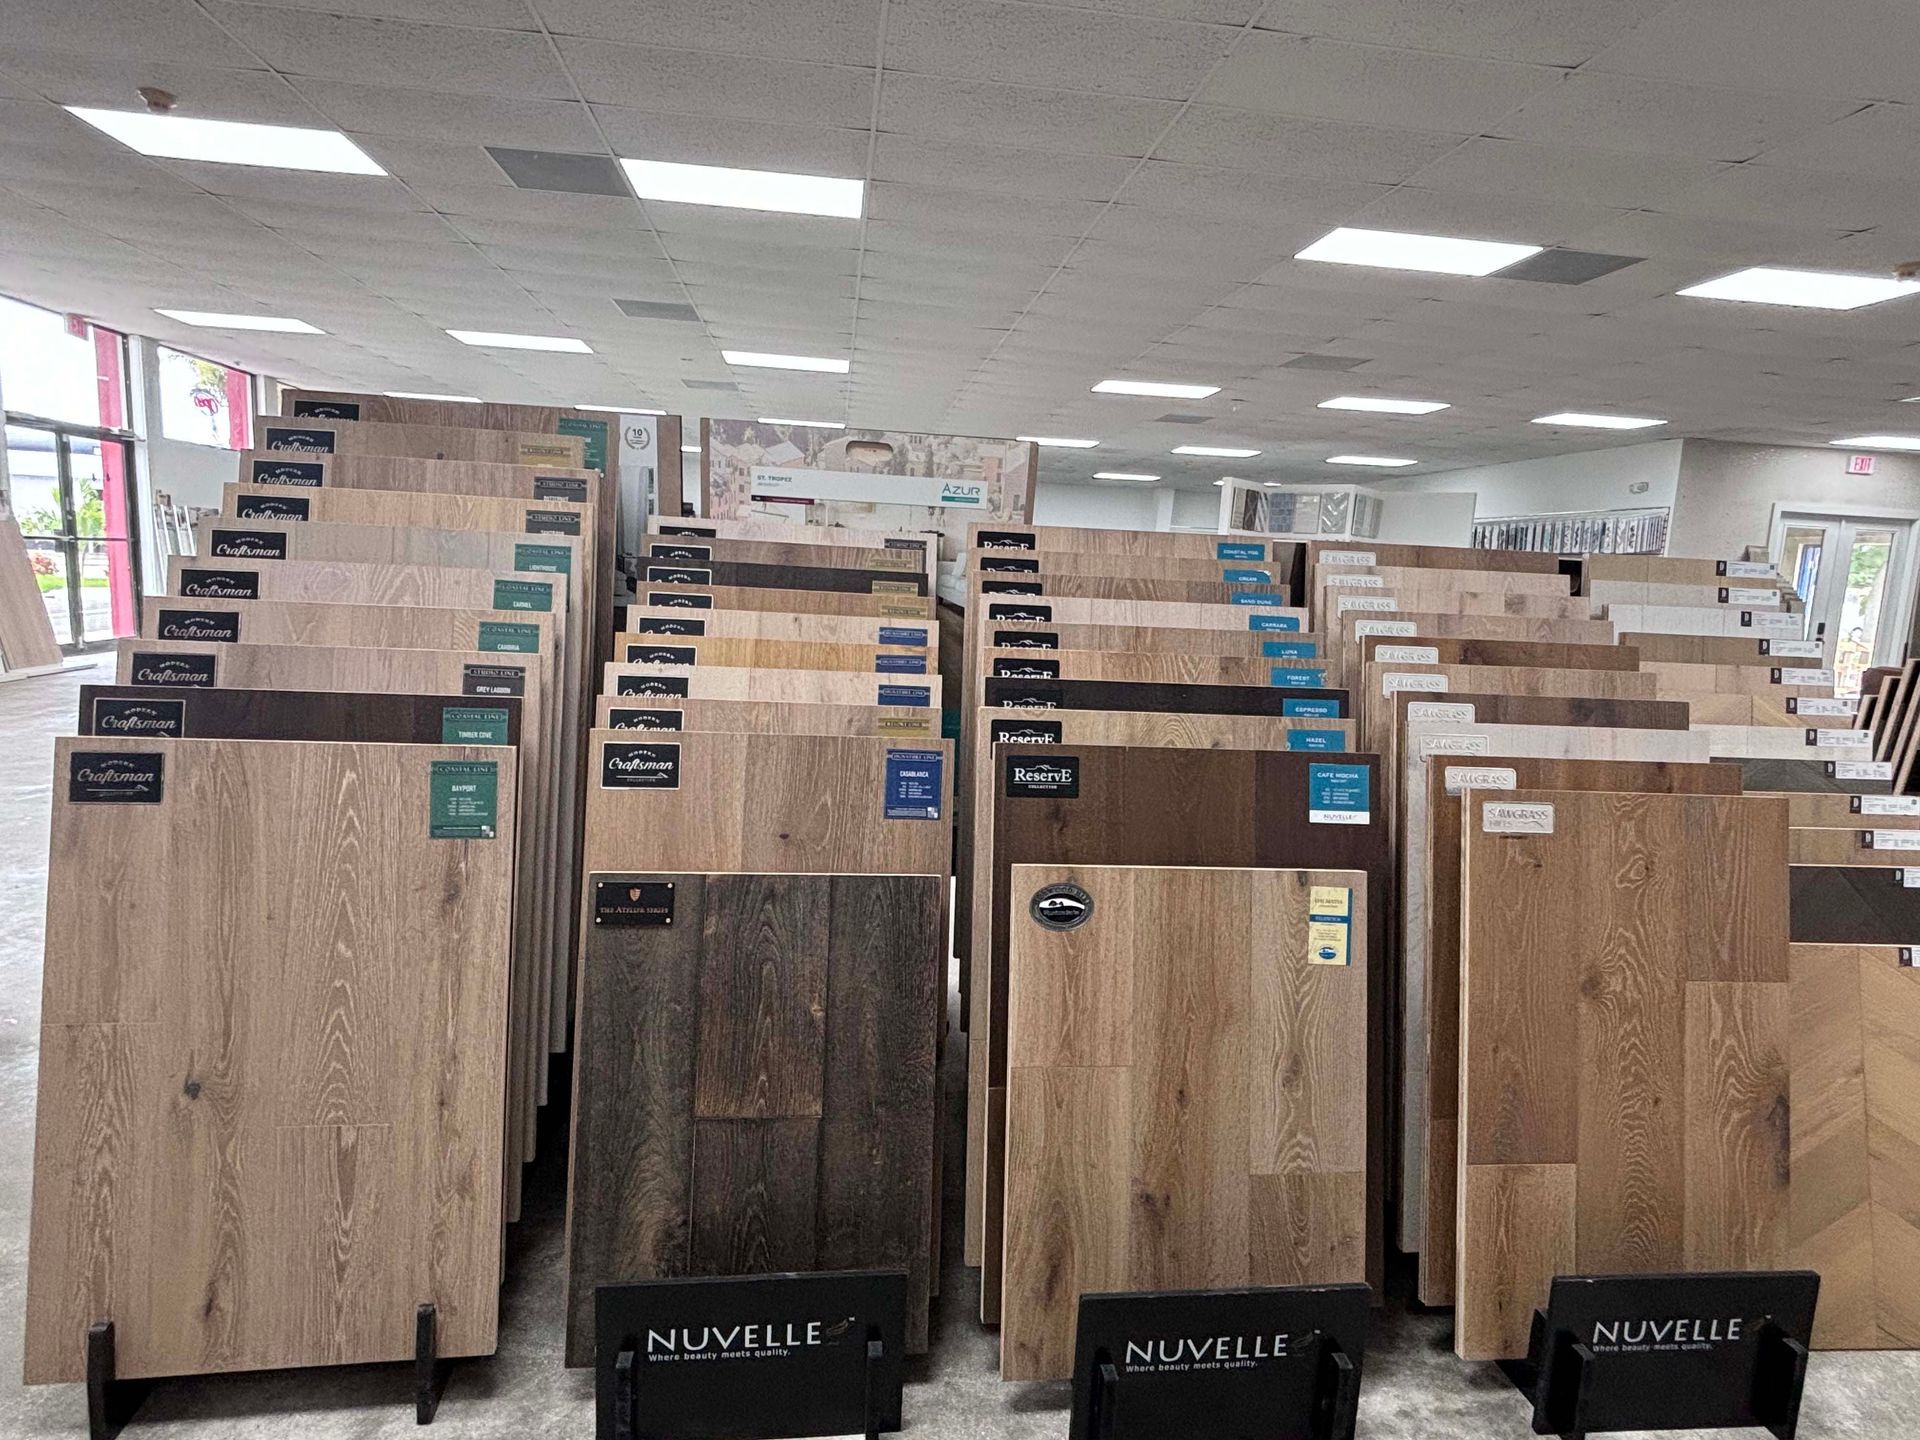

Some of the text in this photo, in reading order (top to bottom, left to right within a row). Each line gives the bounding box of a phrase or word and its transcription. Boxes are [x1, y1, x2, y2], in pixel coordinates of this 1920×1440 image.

[271, 440, 329, 453] Craftsman
[1854, 457, 1872, 472] EXIT
[258, 473, 317, 486] Craftsman
[241, 508, 303, 521] Craftsman
[216, 543, 280, 557] Craftsman
[186, 583, 252, 598] Craftsman
[164, 625, 232, 639] Craftsman
[137, 668, 208, 683] Craftsman
[101, 715, 177, 731] Craftsman
[608, 757, 673, 772] Craftsman
[77, 768, 154, 784] Craftsman
[900, 770, 928, 778] CASABLANCA
[647, 1321, 822, 1353] NUVELLE
[1592, 1318, 1743, 1344] NUVELLE
[1125, 1334, 1289, 1364] NUVELLE
[1593, 1344, 1620, 1352] Where
[1622, 1343, 1650, 1352] beauty
[1653, 1342, 1679, 1350] meets
[648, 1348, 791, 1362] Where beauty meets quality.
[1125, 1359, 1258, 1373] Where beauty meets quality.
